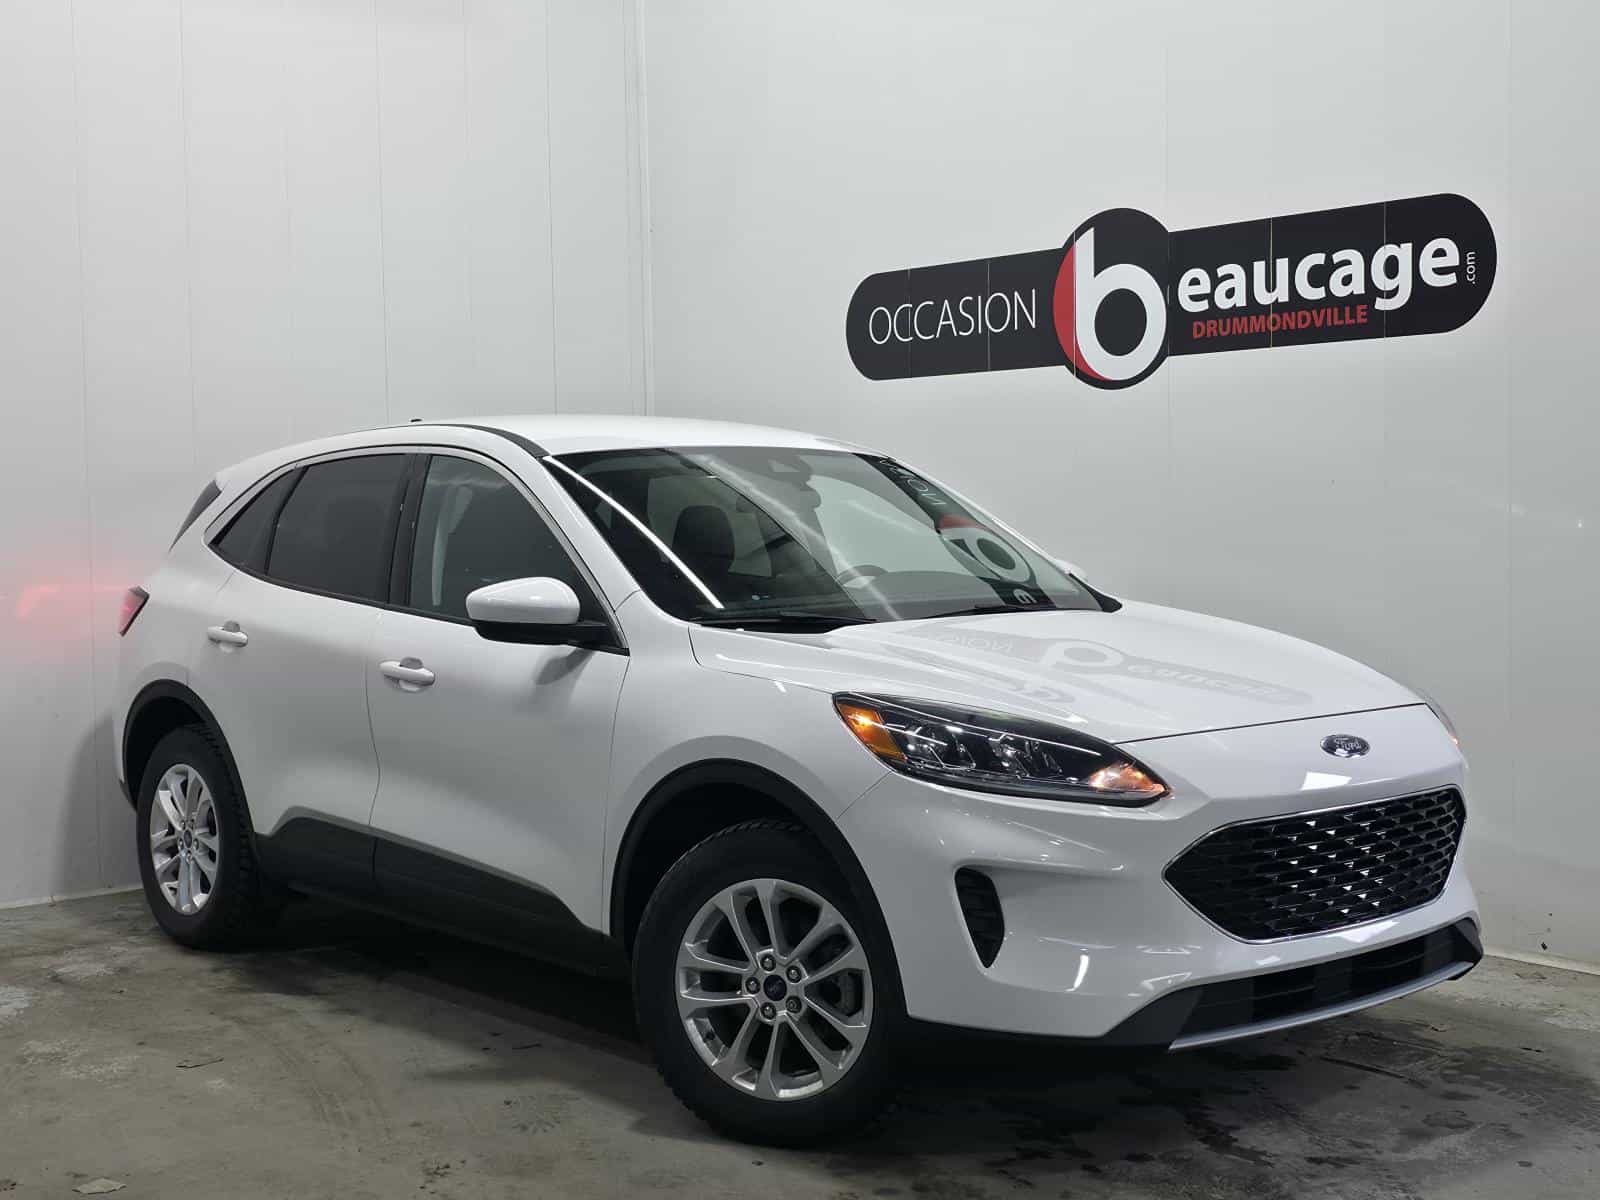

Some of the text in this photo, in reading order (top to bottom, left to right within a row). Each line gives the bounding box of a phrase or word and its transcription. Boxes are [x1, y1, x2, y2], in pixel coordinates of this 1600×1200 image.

[868, 288, 1037, 345] OCCASION
[1466, 251, 1476, 285] .com
[1192, 304, 1369, 340] DRUMMONDVILLE
